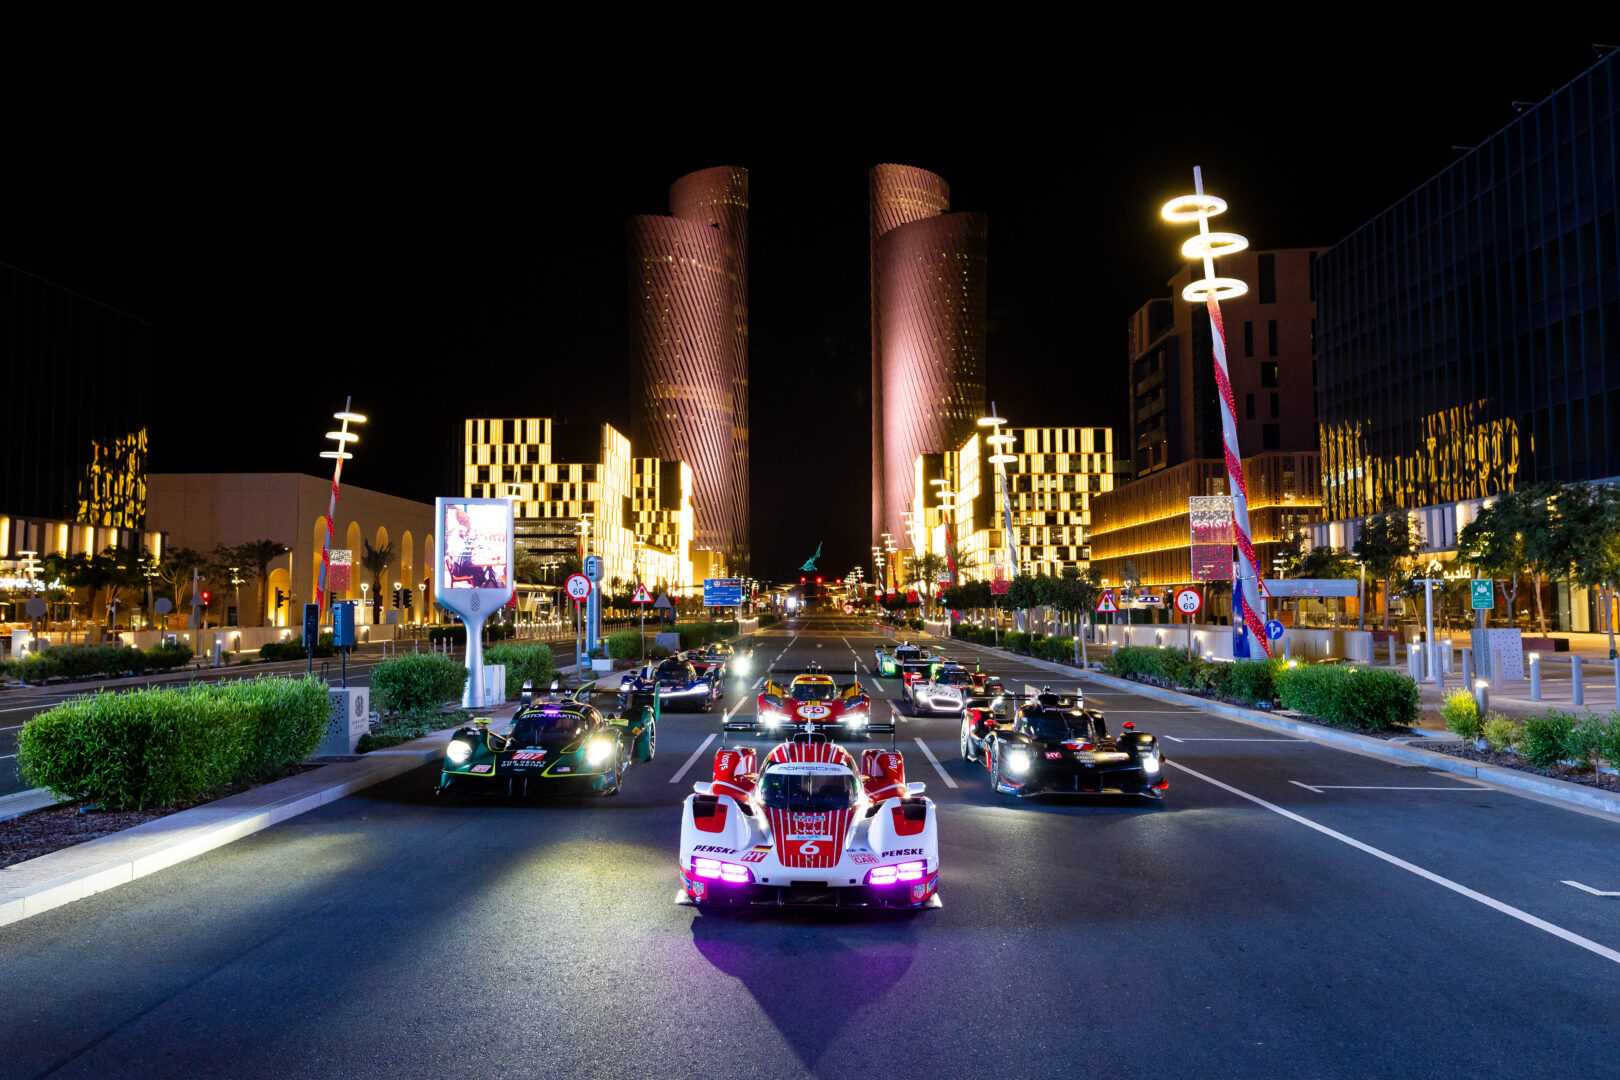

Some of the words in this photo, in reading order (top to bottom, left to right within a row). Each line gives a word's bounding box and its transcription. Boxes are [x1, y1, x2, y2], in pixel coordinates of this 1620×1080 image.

[572, 587, 584, 596] 60
[1183, 602, 1195, 611] 60
[804, 706, 824, 714] 50
[548, 712, 581, 721] MARTIN
[513, 752, 544, 760] 007
[692, 844, 738, 855] PENSKE
[799, 840, 820, 855] 6
[743, 851, 766, 862] HY
[881, 848, 924, 858] PENSKE
